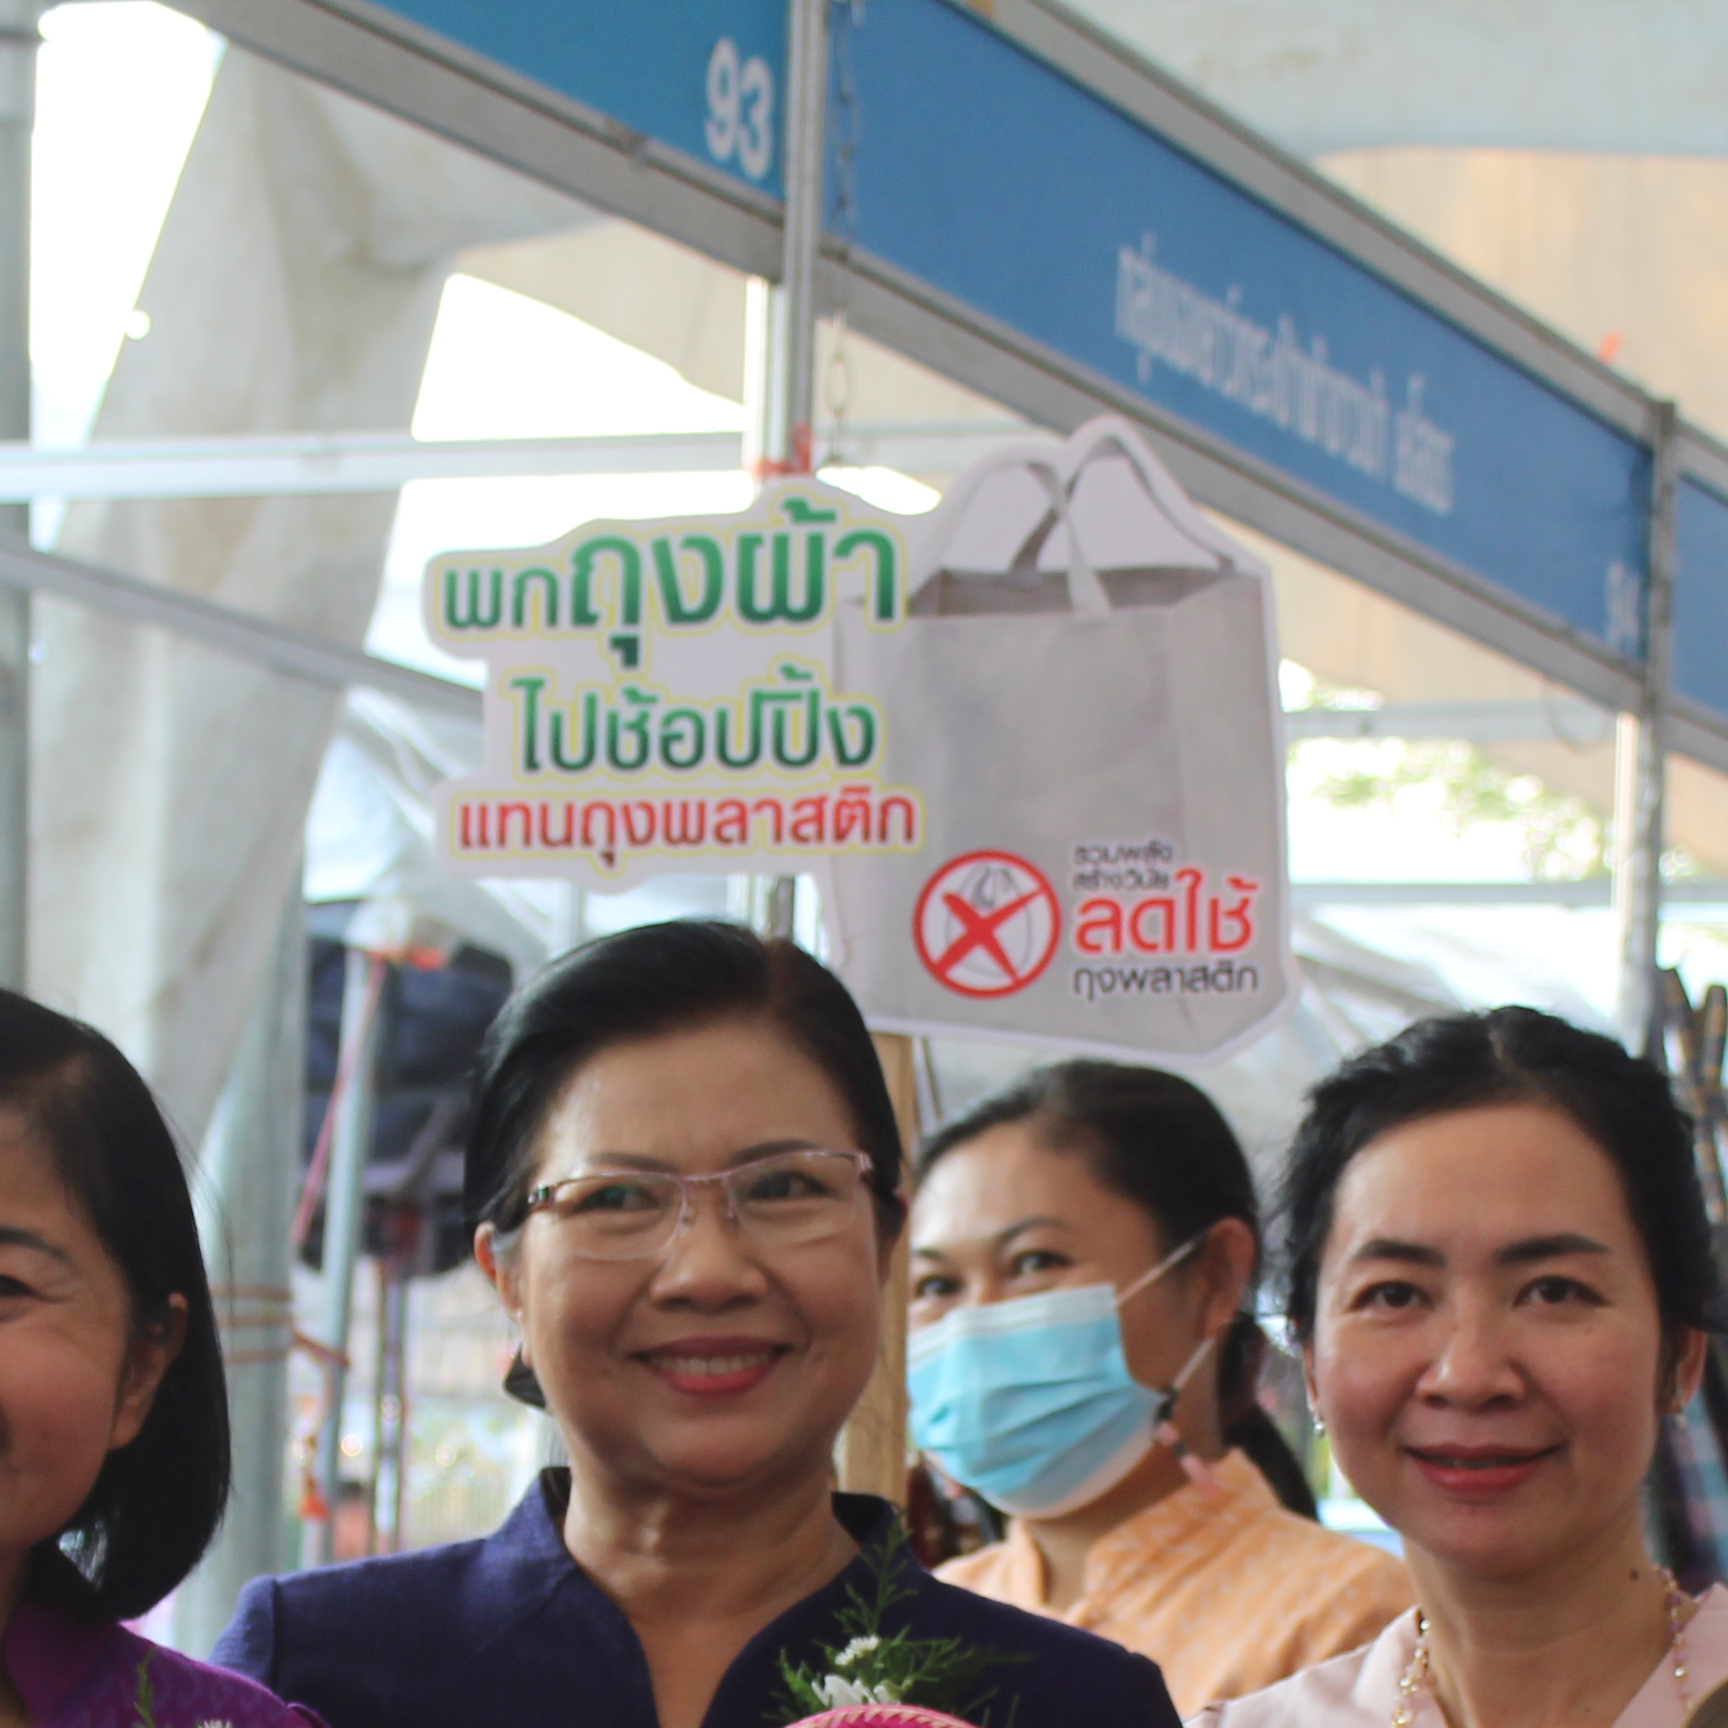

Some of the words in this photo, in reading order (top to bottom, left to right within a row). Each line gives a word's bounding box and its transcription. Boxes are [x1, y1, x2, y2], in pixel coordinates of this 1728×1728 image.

[706, 37, 773, 178] 93
[445, 497, 896, 668] พกถุงผ้า
[511, 663, 877, 774] ไปช้อปปิ้ง
[458, 786, 915, 868] แทนถุงพลาสติก
[1075, 866, 1259, 954] ลดใช้
[1073, 960, 1258, 1002] ถุงพลาสติก
